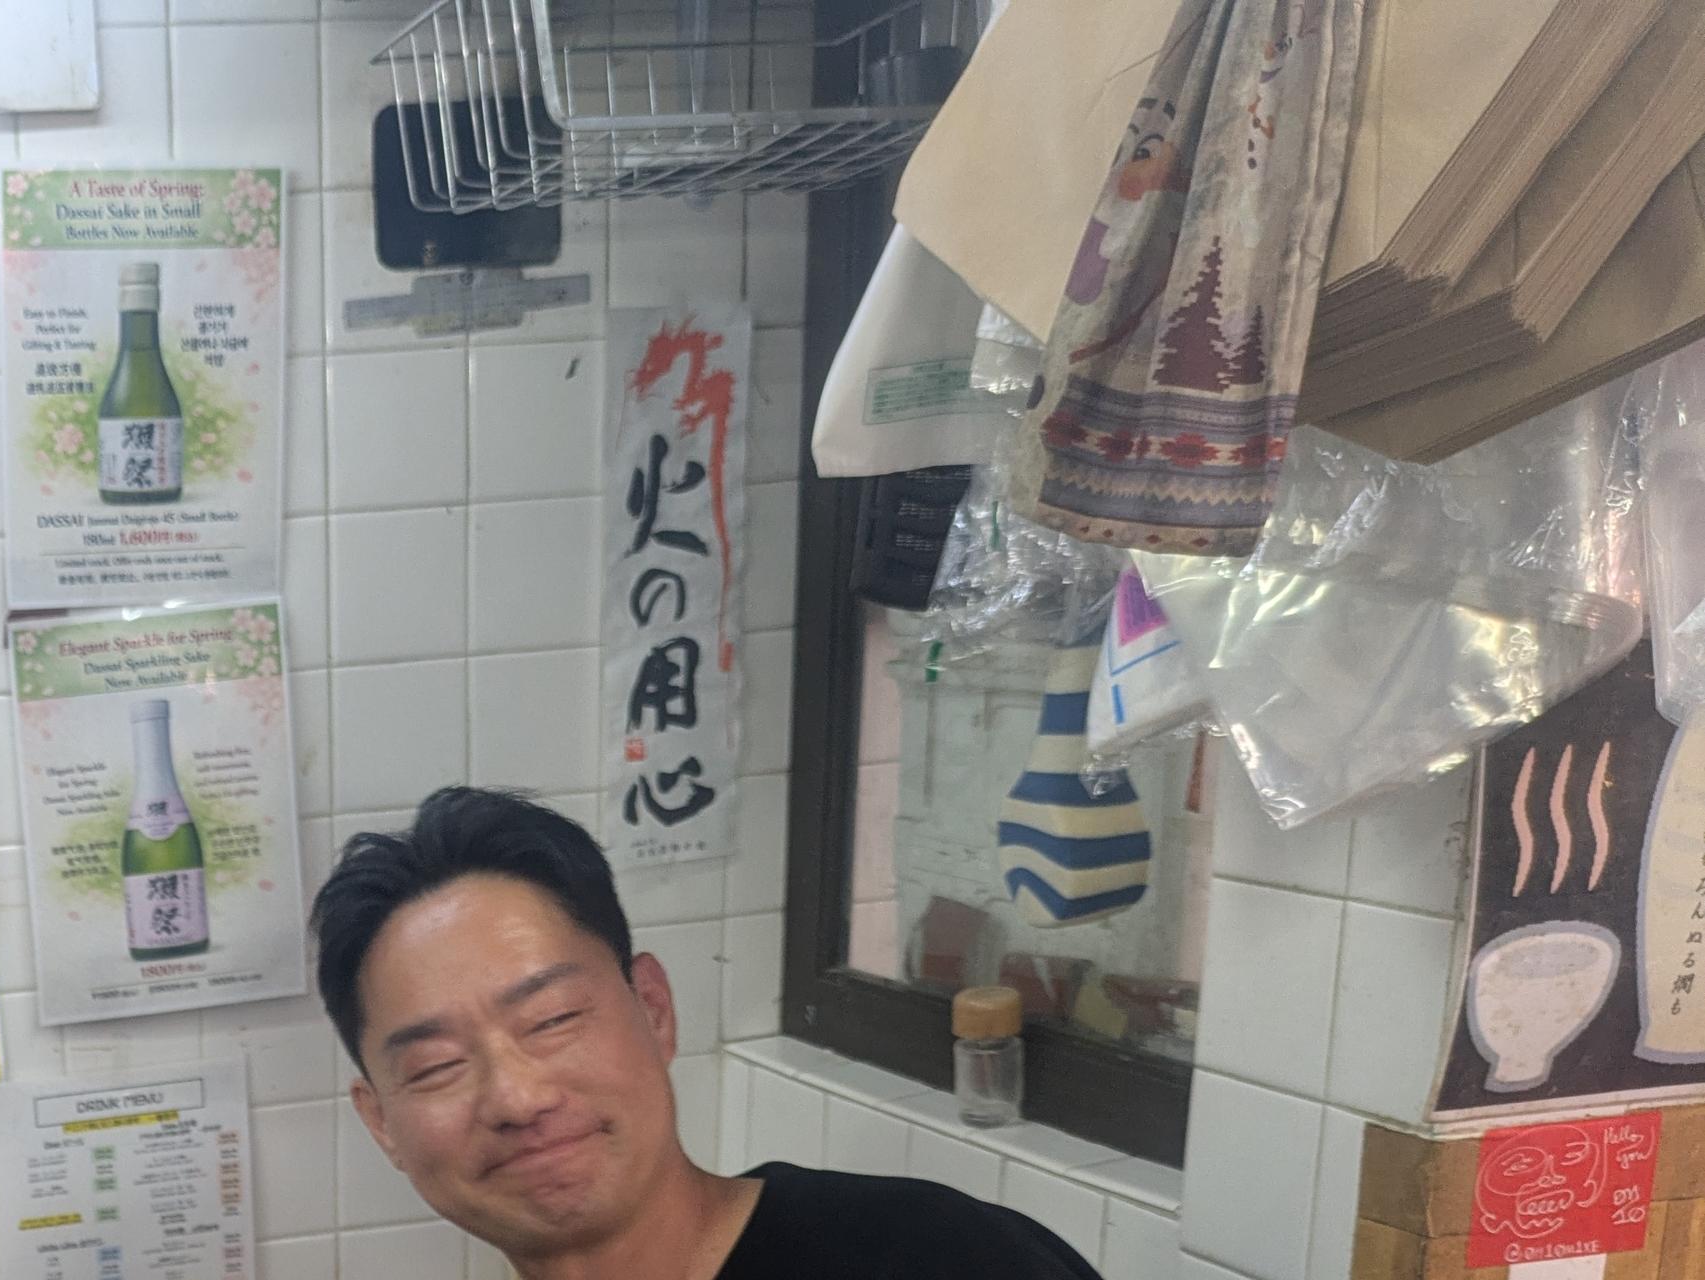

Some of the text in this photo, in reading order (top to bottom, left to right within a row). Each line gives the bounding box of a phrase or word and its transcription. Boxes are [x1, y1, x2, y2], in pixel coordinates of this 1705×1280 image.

[71, 180, 81, 198] A
[88, 178, 125, 197] Taste
[129, 179, 146, 197] of
[106, 201, 140, 220] Sake
[144, 204, 156, 219] in
[161, 199, 201, 219] Small
[112, 224, 139, 239] Now
[146, 223, 200, 240] Available
[37, 514, 84, 529] DASSAI
[622, 433, 716, 828] 火の用心
[59, 628, 233, 658] Elegant Sparkle for Spring
